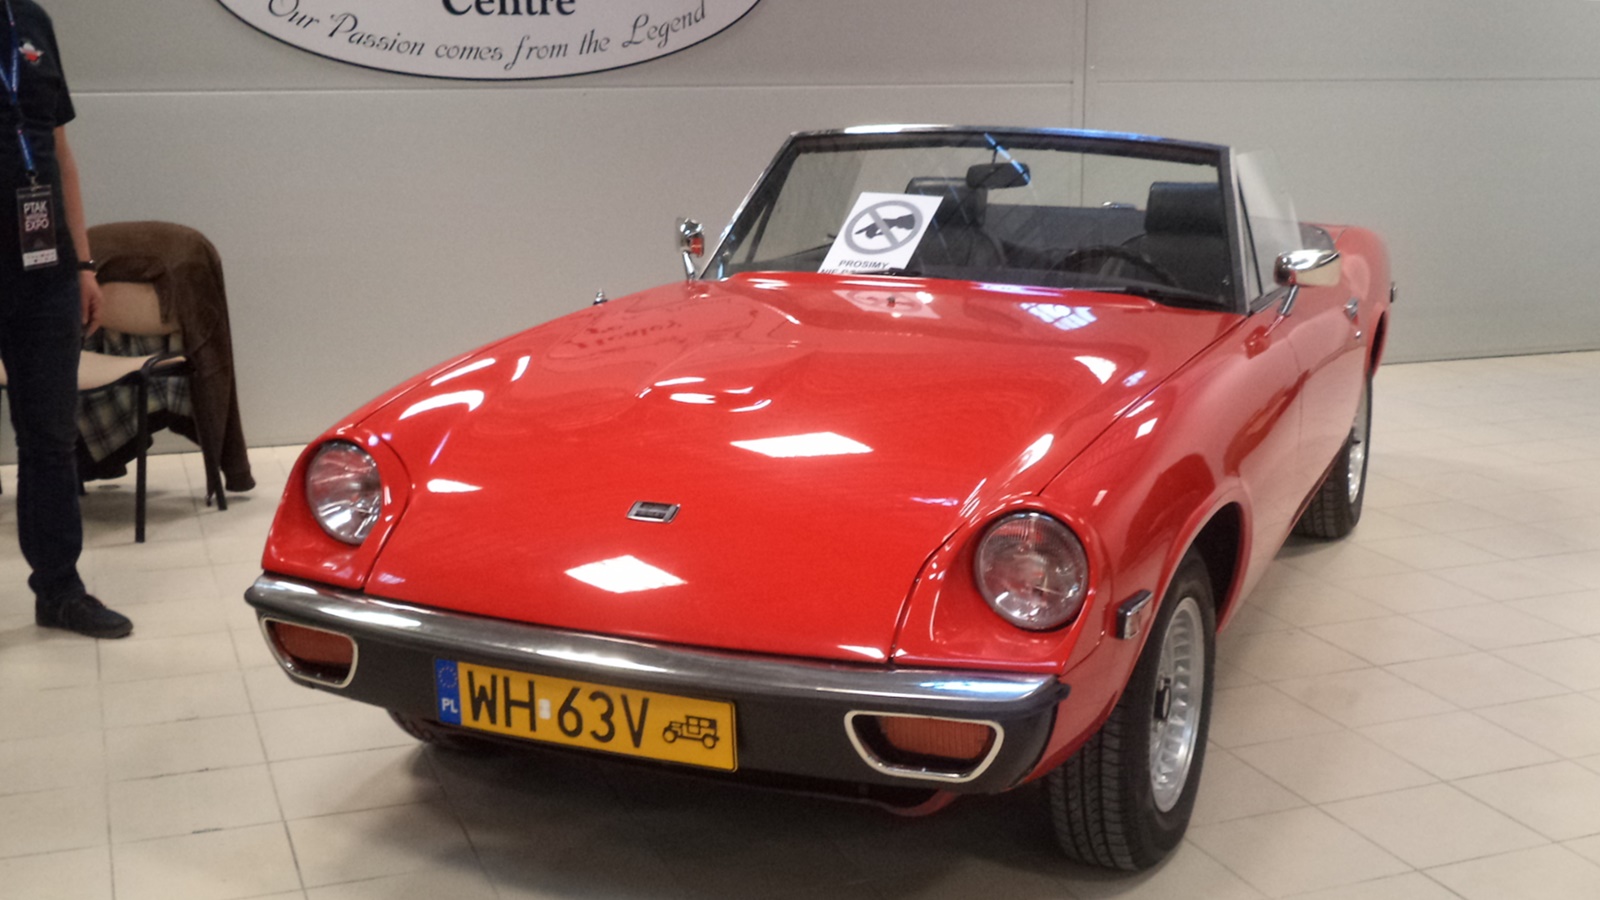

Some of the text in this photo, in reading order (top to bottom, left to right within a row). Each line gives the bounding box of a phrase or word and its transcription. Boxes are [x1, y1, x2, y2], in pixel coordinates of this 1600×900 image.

[441, 0, 577, 16] Centre
[268, 0, 706, 71] Our Passion comes from the Legend
[23, 200, 48, 215] PTAK
[25, 217, 50, 232] EXPO
[838, 260, 889, 269] PROSIMY
[441, 697, 459, 714] PL
[467, 670, 650, 749] WH 63V
